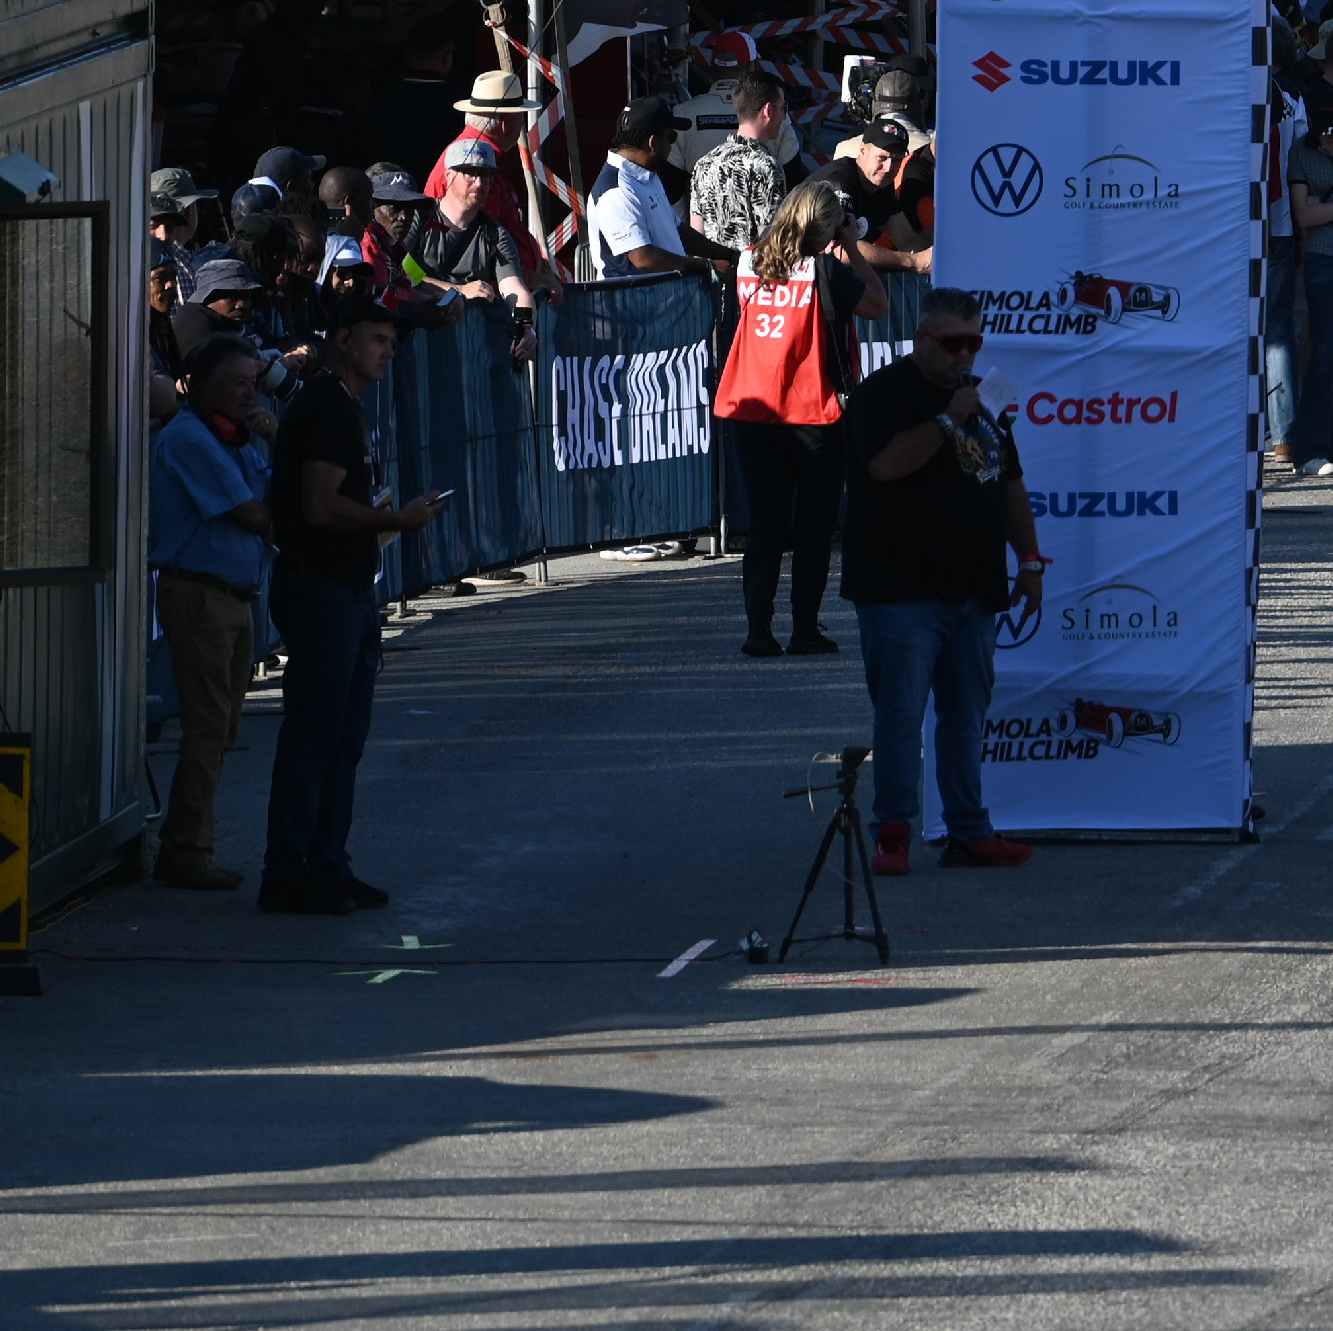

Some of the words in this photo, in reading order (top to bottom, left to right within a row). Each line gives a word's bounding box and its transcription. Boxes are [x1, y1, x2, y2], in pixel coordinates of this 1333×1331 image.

[1019, 58, 1181, 87] SUZUKI
[1064, 176, 1179, 199] Simola
[1064, 201, 1086, 210] GOLF
[1098, 201, 1145, 210] COUNTRY
[1147, 201, 1179, 210] ESTATE
[738, 281, 814, 308] MEDIA
[1135, 291, 1147, 303] 14
[754, 313, 785, 339] 32
[980, 313, 1097, 335] HILLCLIMB
[552, 354, 624, 473] CHASE
[625, 339, 711, 466] DREAMS
[1025, 390, 1179, 426] Castrol
[1027, 490, 1179, 518] SUZUKI
[1062, 605, 1179, 631] Simola
[1062, 632, 1086, 641] GOLF
[1088, 632, 1095, 641] &
[1097, 631, 1142, 641] COUNTRY
[1145, 630, 1179, 640] ESTATE
[981, 718, 1052, 740] MOLA
[981, 739, 1100, 763] HILLCLIMB
